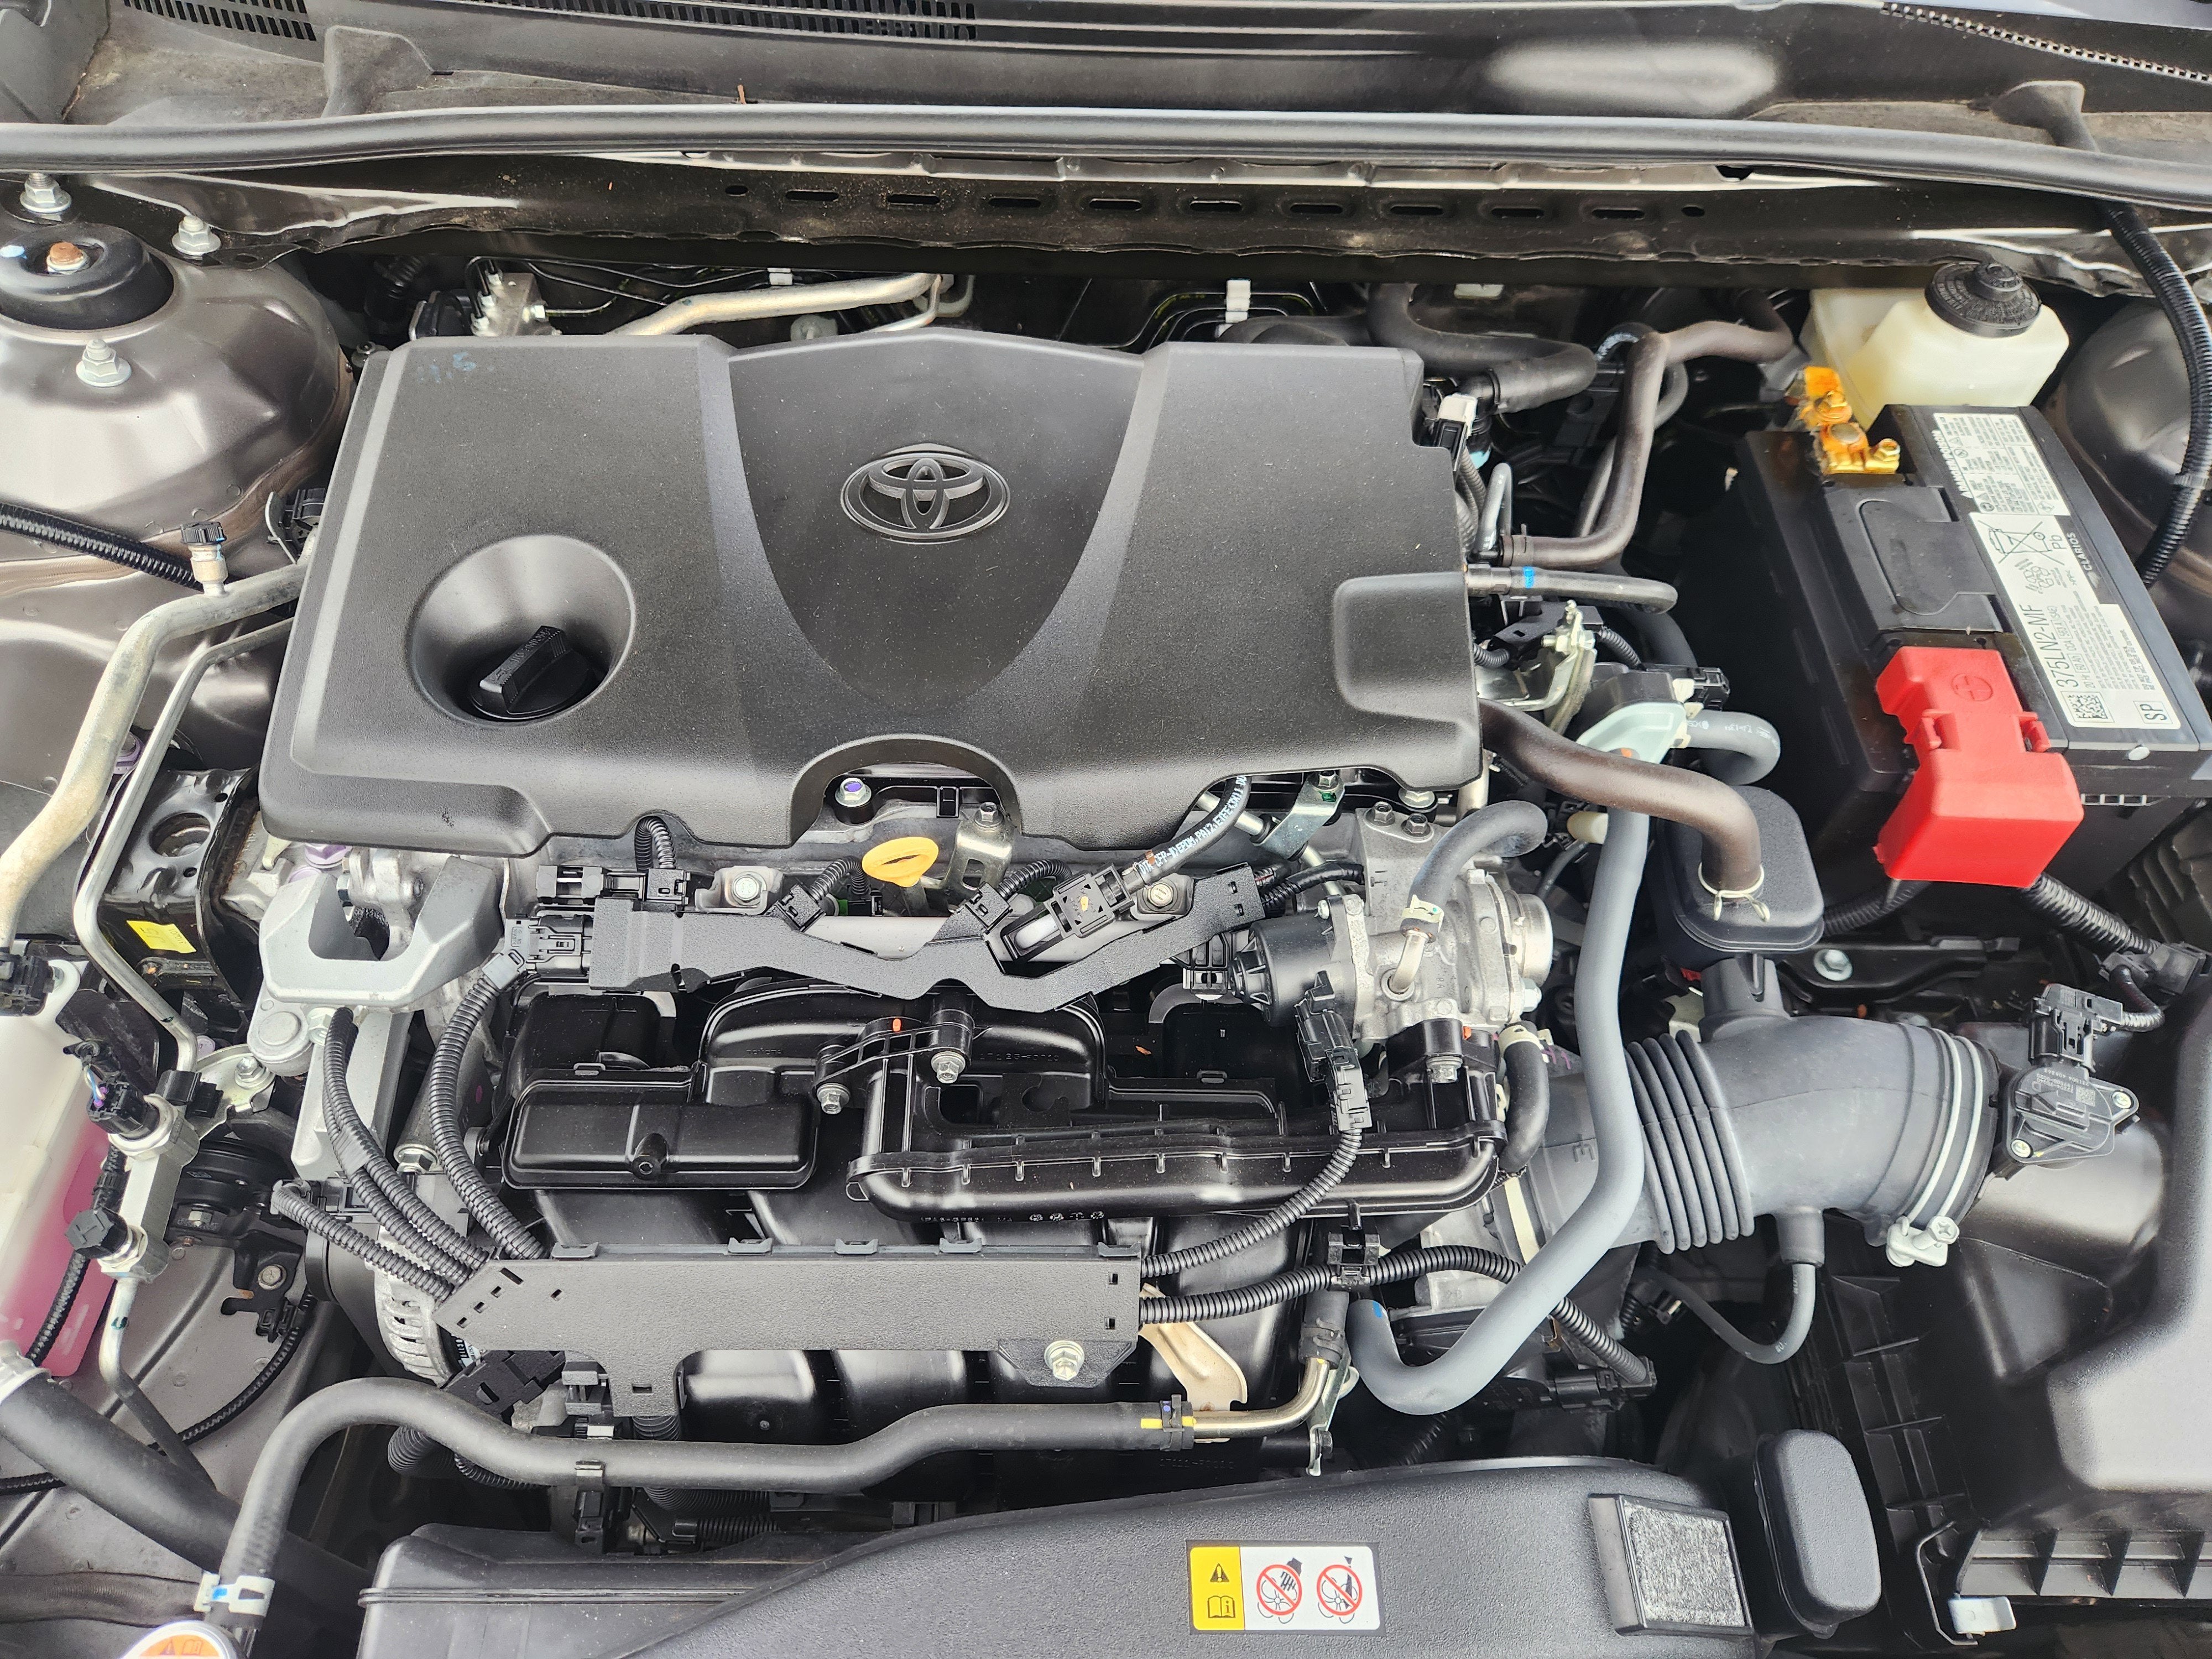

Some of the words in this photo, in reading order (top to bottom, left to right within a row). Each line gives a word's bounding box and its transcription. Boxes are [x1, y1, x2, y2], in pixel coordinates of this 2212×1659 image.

[2047, 534, 2067, 550] Pb
[2068, 531, 2094, 571] CLARIOS
[2019, 604, 2079, 687] 375LN2-MF
[2138, 703, 2168, 721] SP
